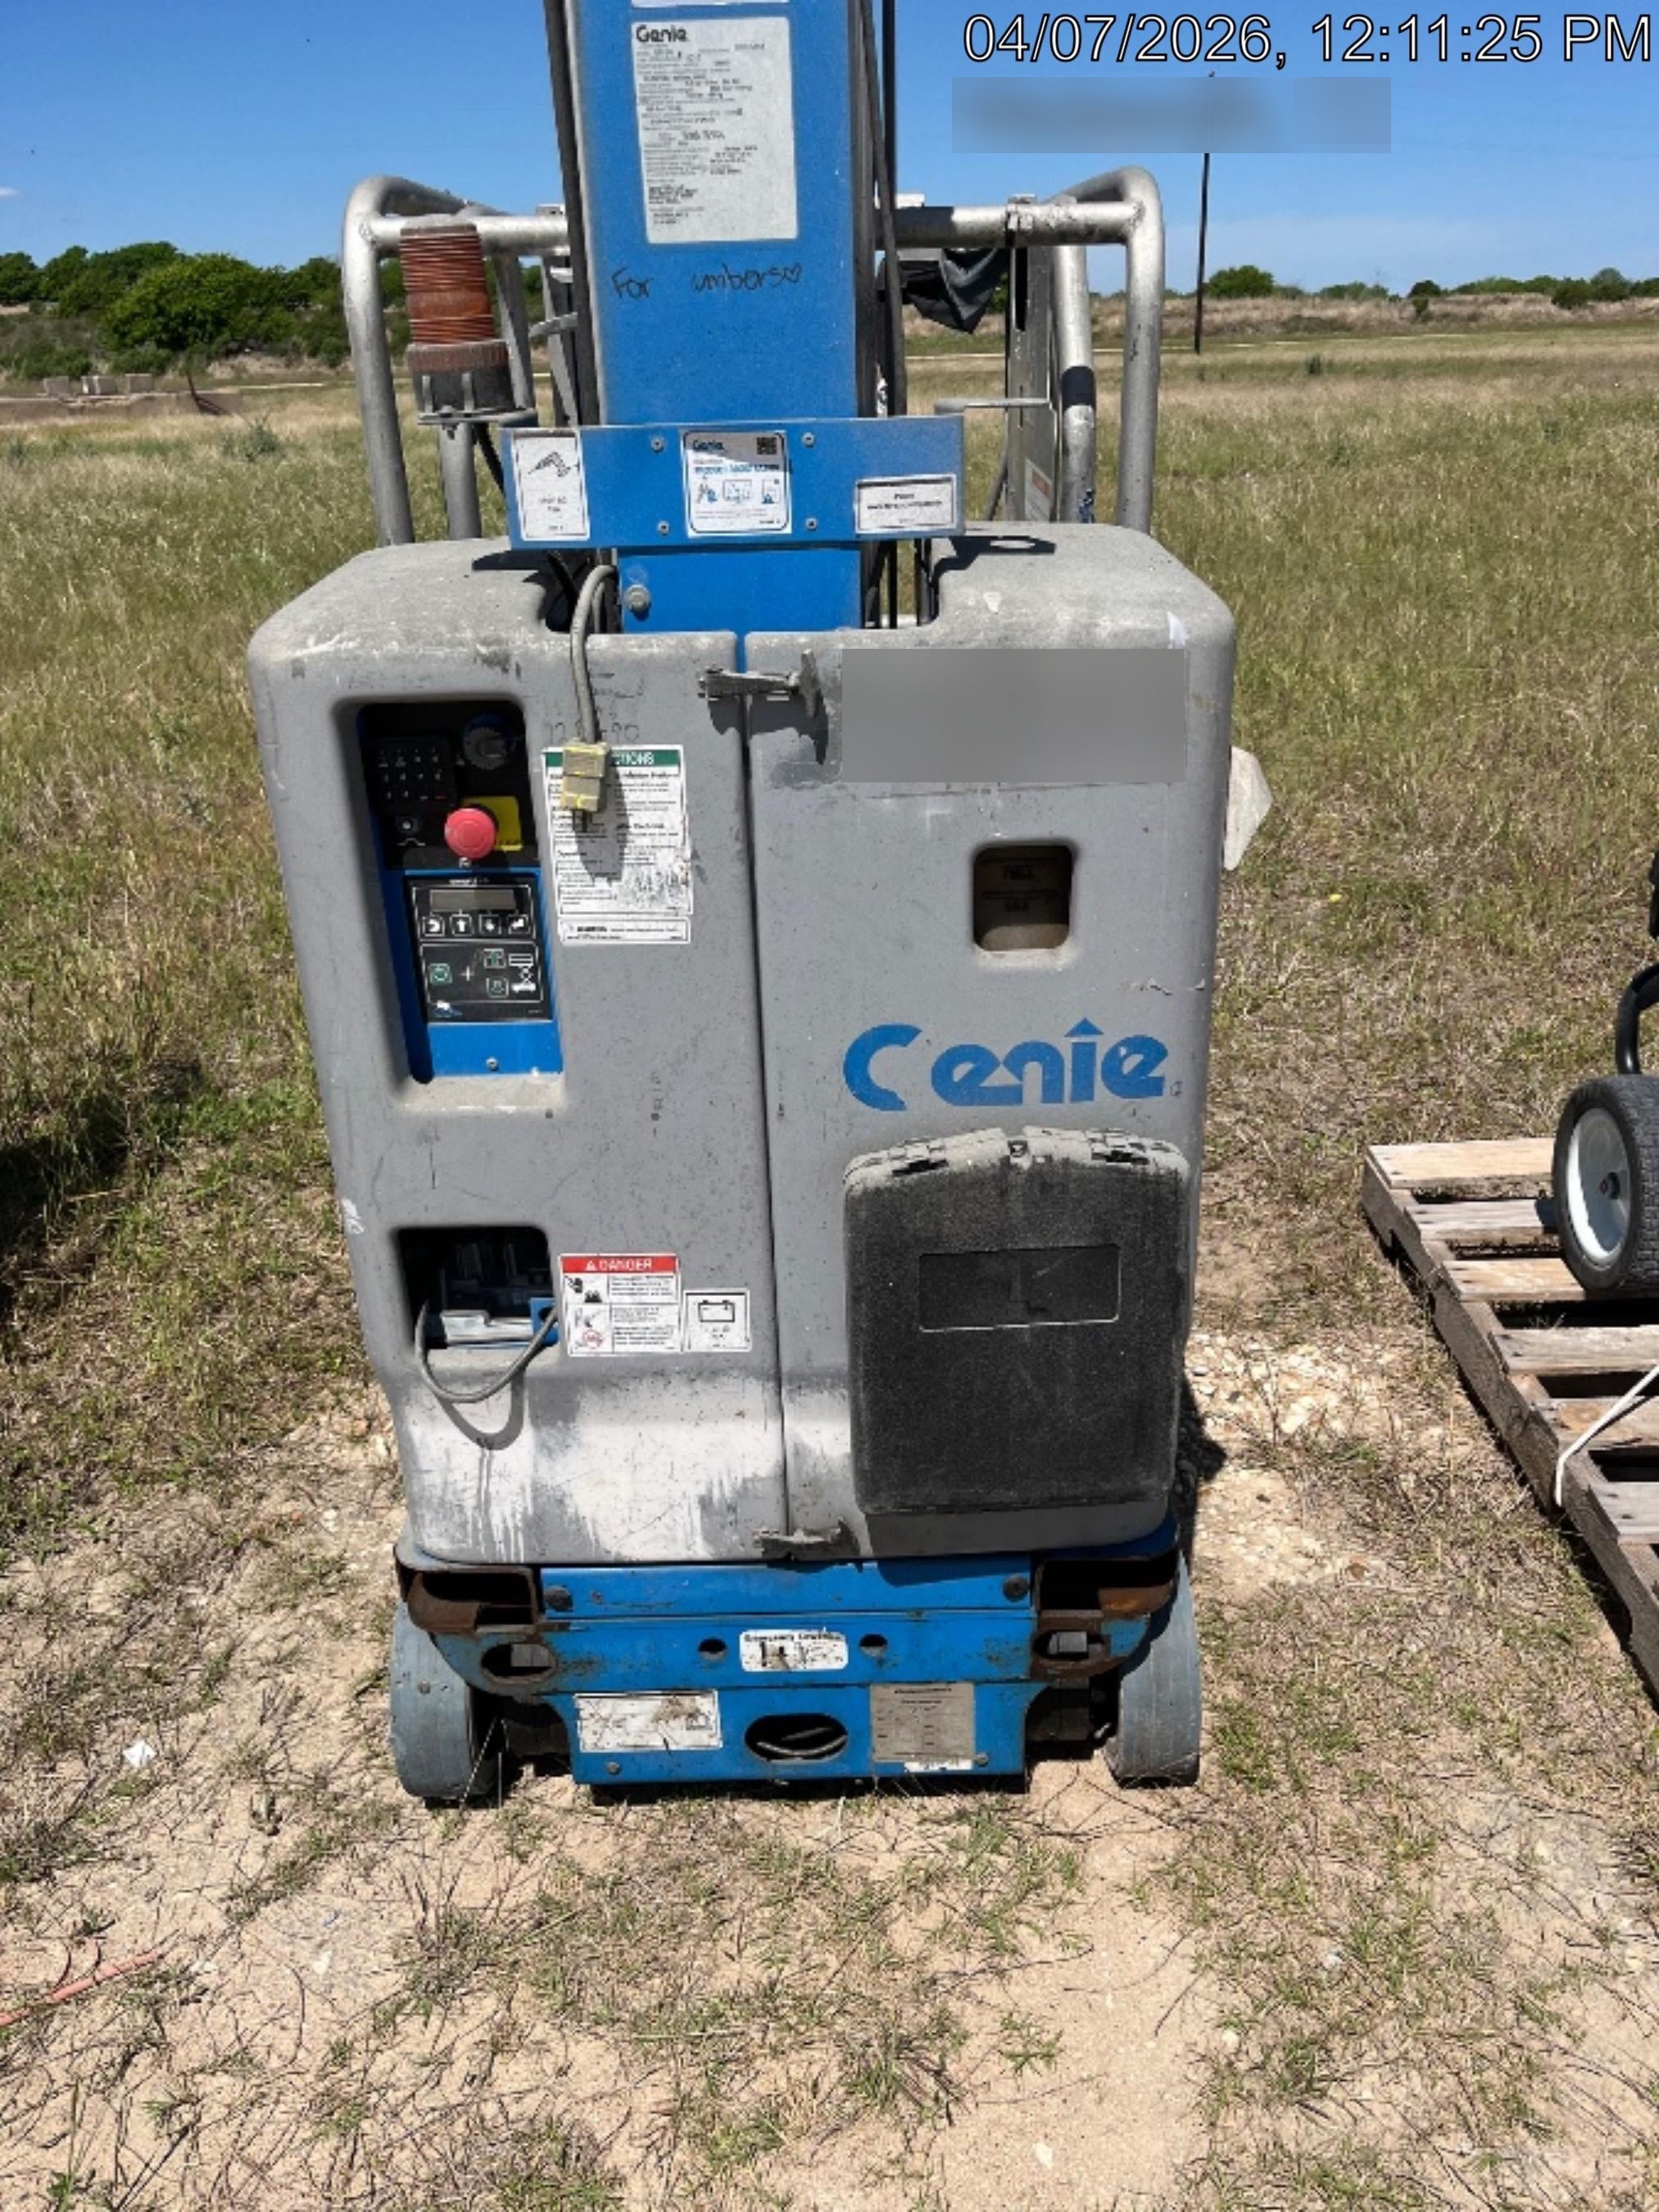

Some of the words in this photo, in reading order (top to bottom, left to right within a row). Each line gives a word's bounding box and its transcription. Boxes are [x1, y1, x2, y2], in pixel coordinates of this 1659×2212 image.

[636, 24, 687, 43] Genie
[612, 267, 651, 299] For
[599, 1258, 652, 1271] DANGER
